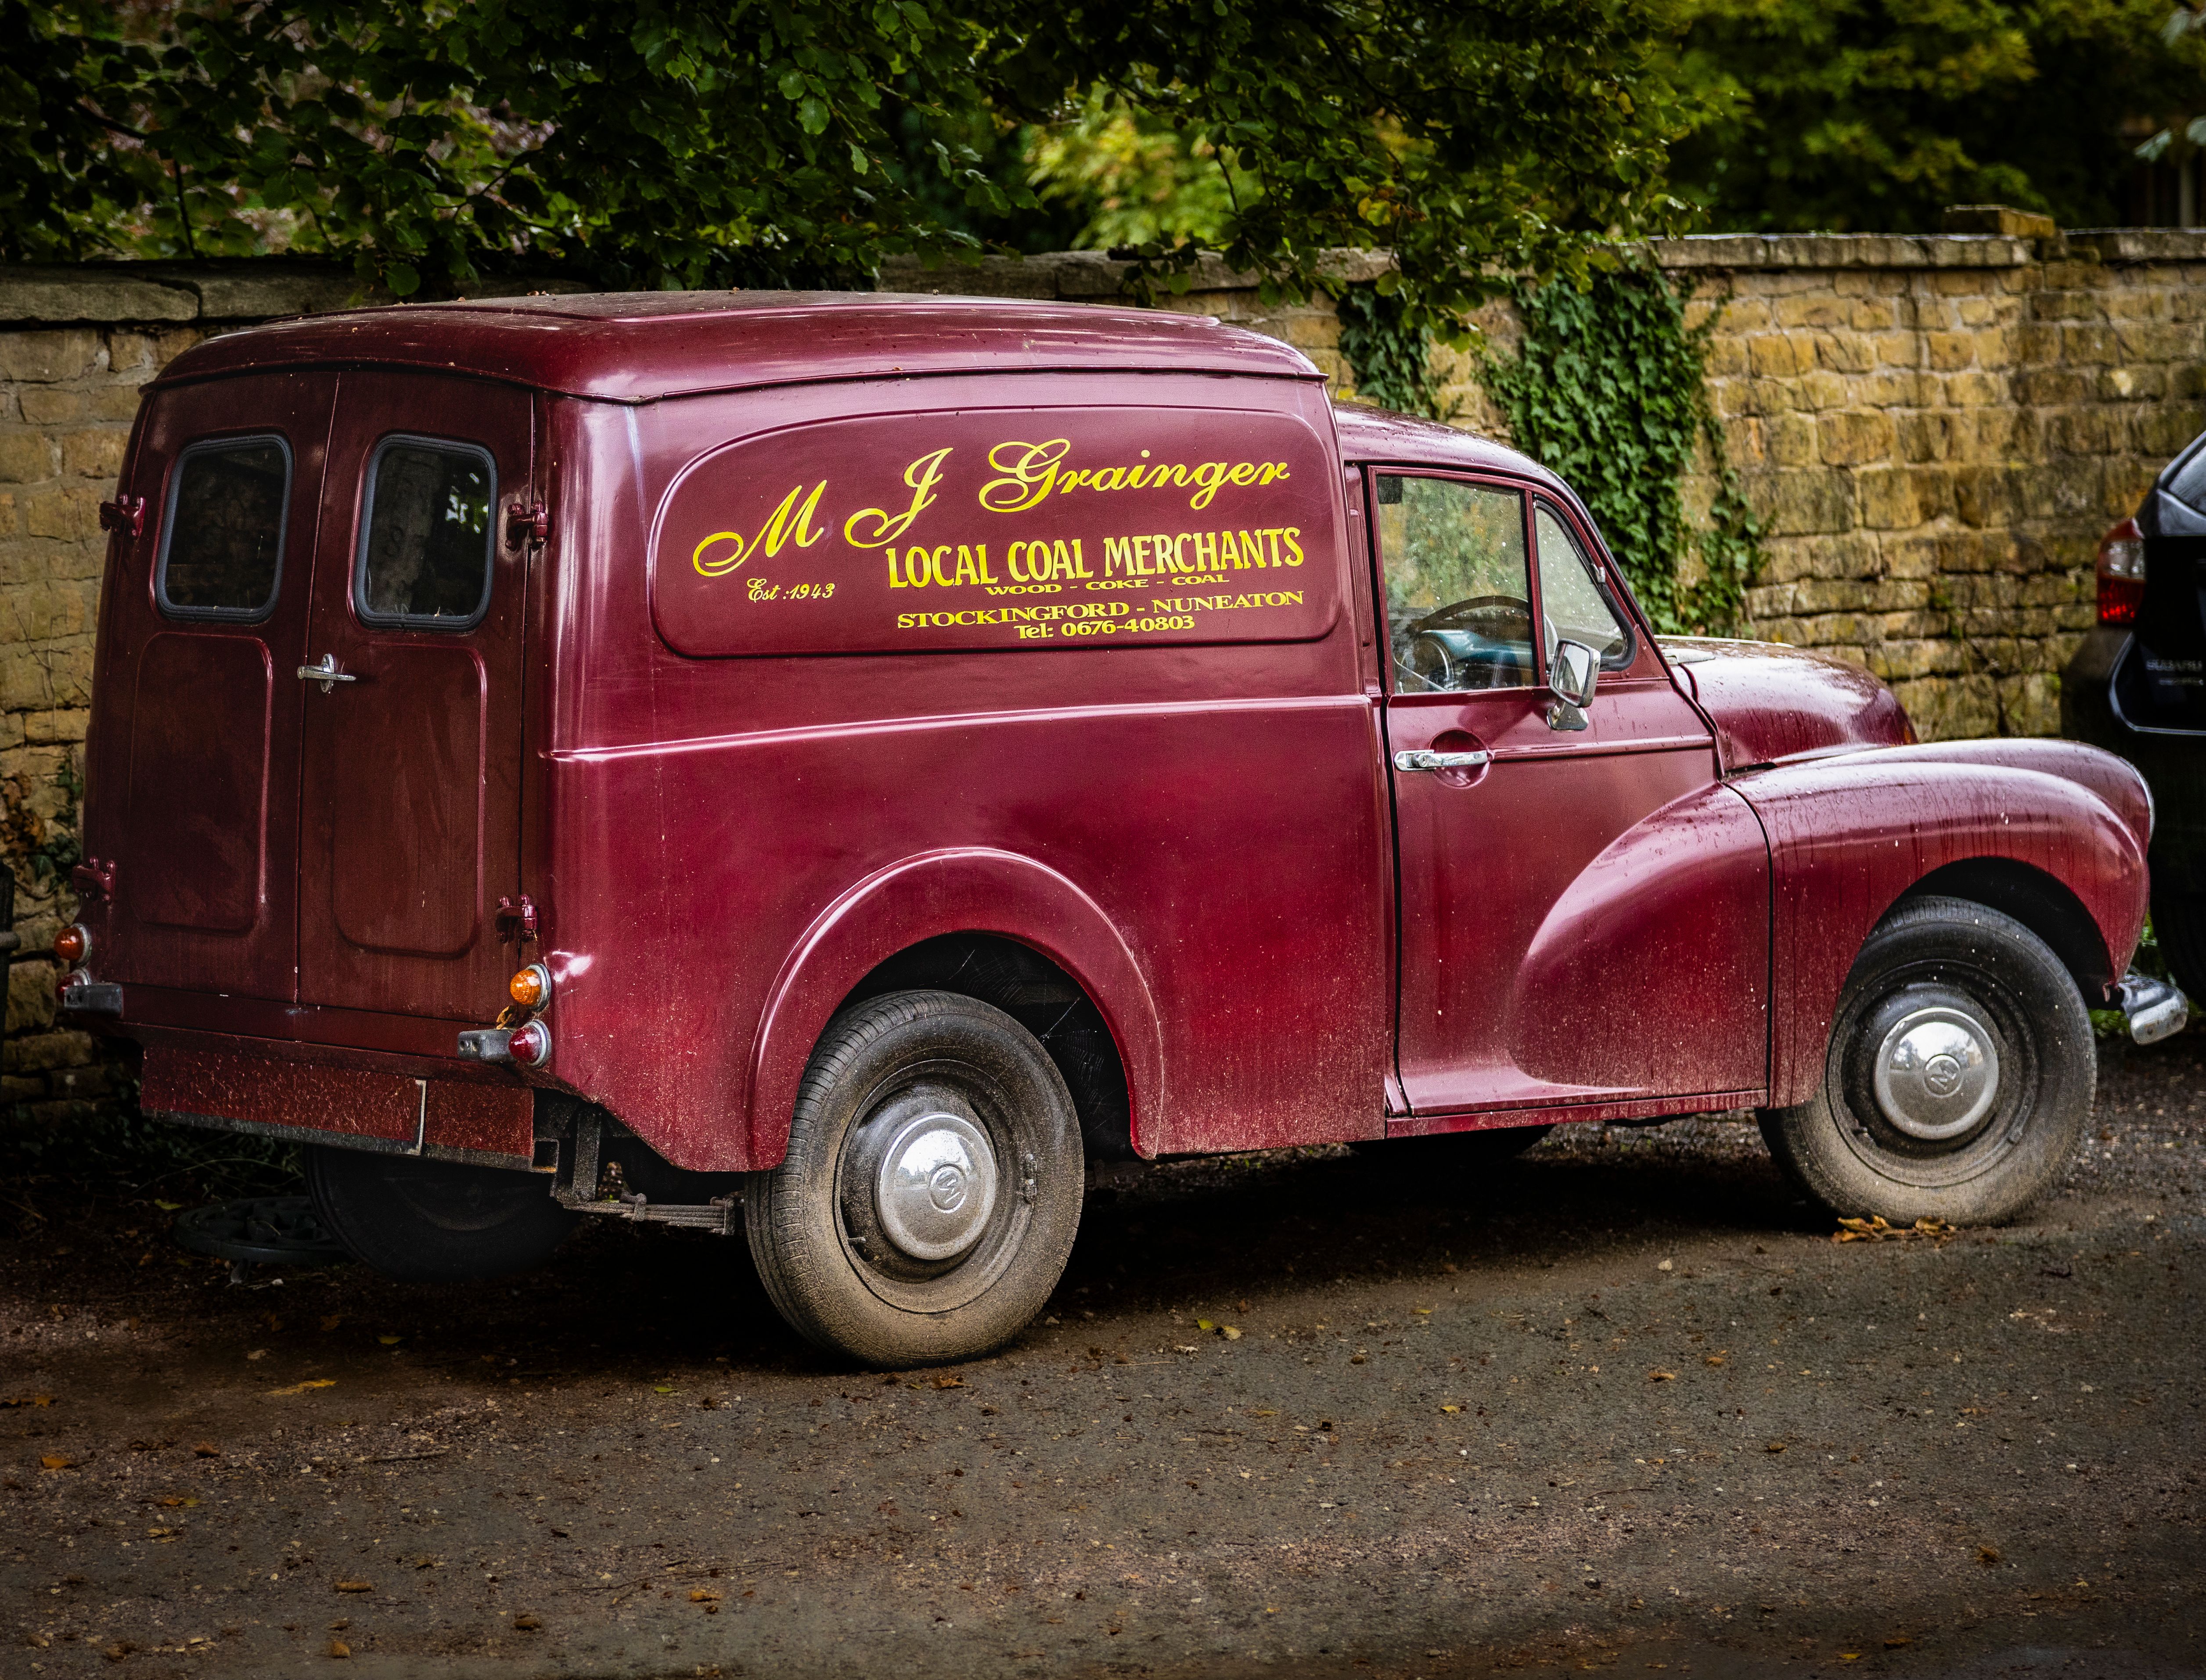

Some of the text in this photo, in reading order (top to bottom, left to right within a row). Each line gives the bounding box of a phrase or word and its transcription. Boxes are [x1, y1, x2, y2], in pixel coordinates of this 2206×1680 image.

[692, 438, 1290, 577] M J Grainger
[885, 526, 1305, 589] LOCAL COAL MERCHANTS
[746, 578, 781, 603] Est
[984, 583, 1062, 596] WOOD
[1085, 578, 1149, 591] COKE
[1171, 573, 1230, 586] COAL
[897, 602, 1130, 629] STOCKINGFORD
[1151, 590, 1304, 614] NUNEATON
[1013, 615, 1196, 640] Tel: 0676-40803
